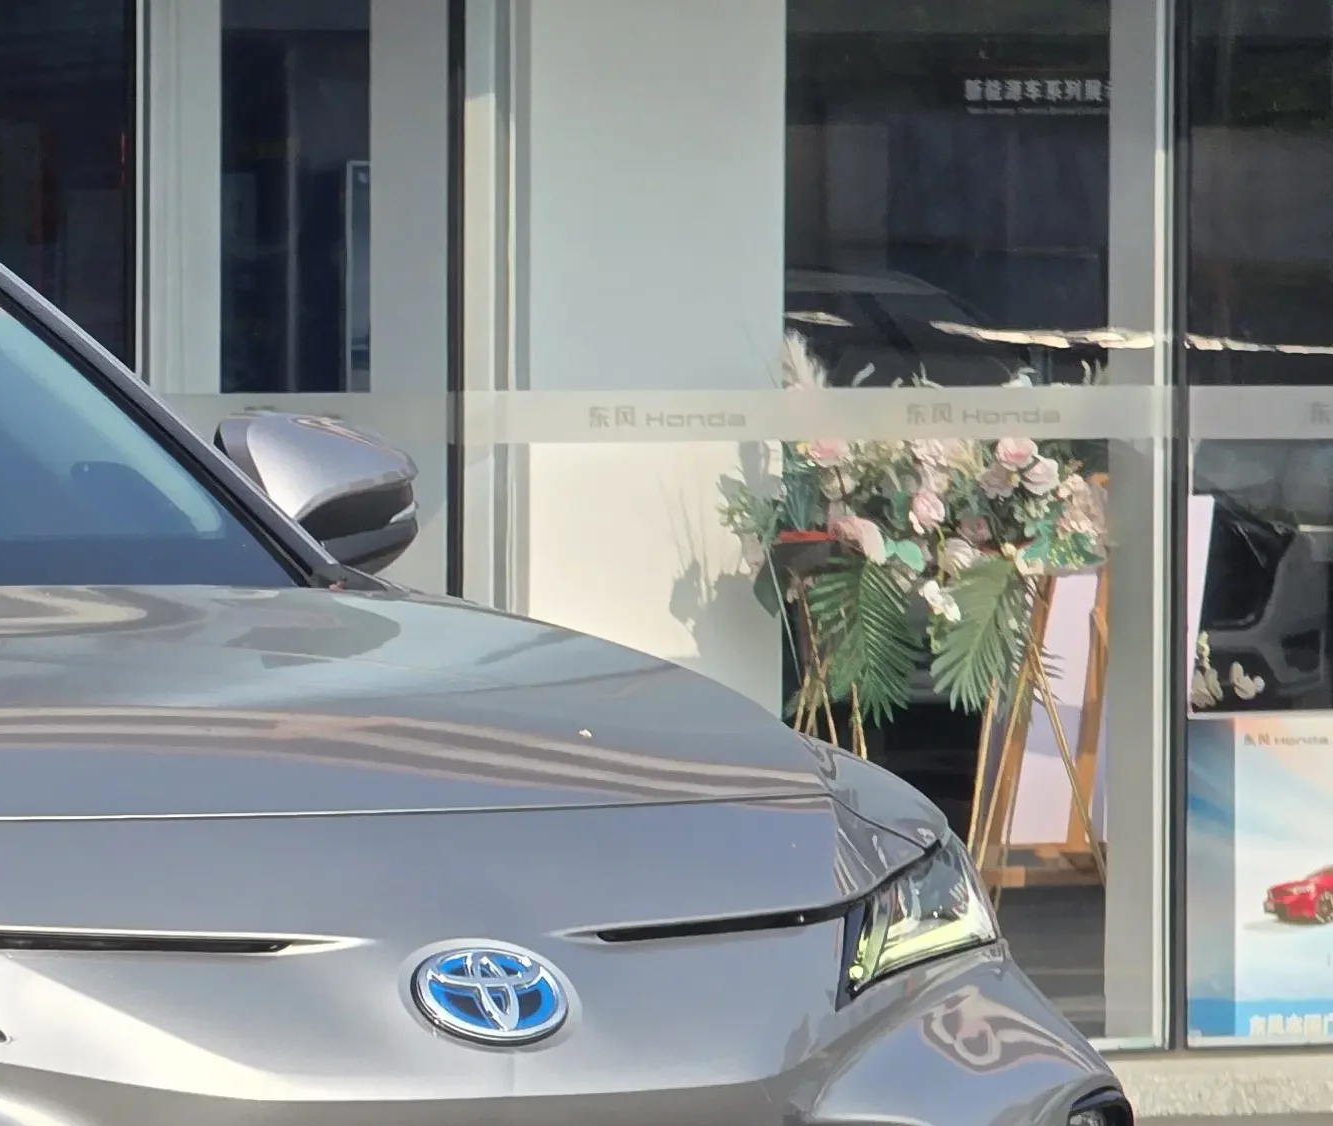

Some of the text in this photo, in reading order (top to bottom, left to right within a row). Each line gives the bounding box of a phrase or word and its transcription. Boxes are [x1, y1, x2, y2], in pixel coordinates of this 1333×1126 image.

[588, 405, 747, 429] 东风 Honda
[961, 407, 1061, 426] Honda
